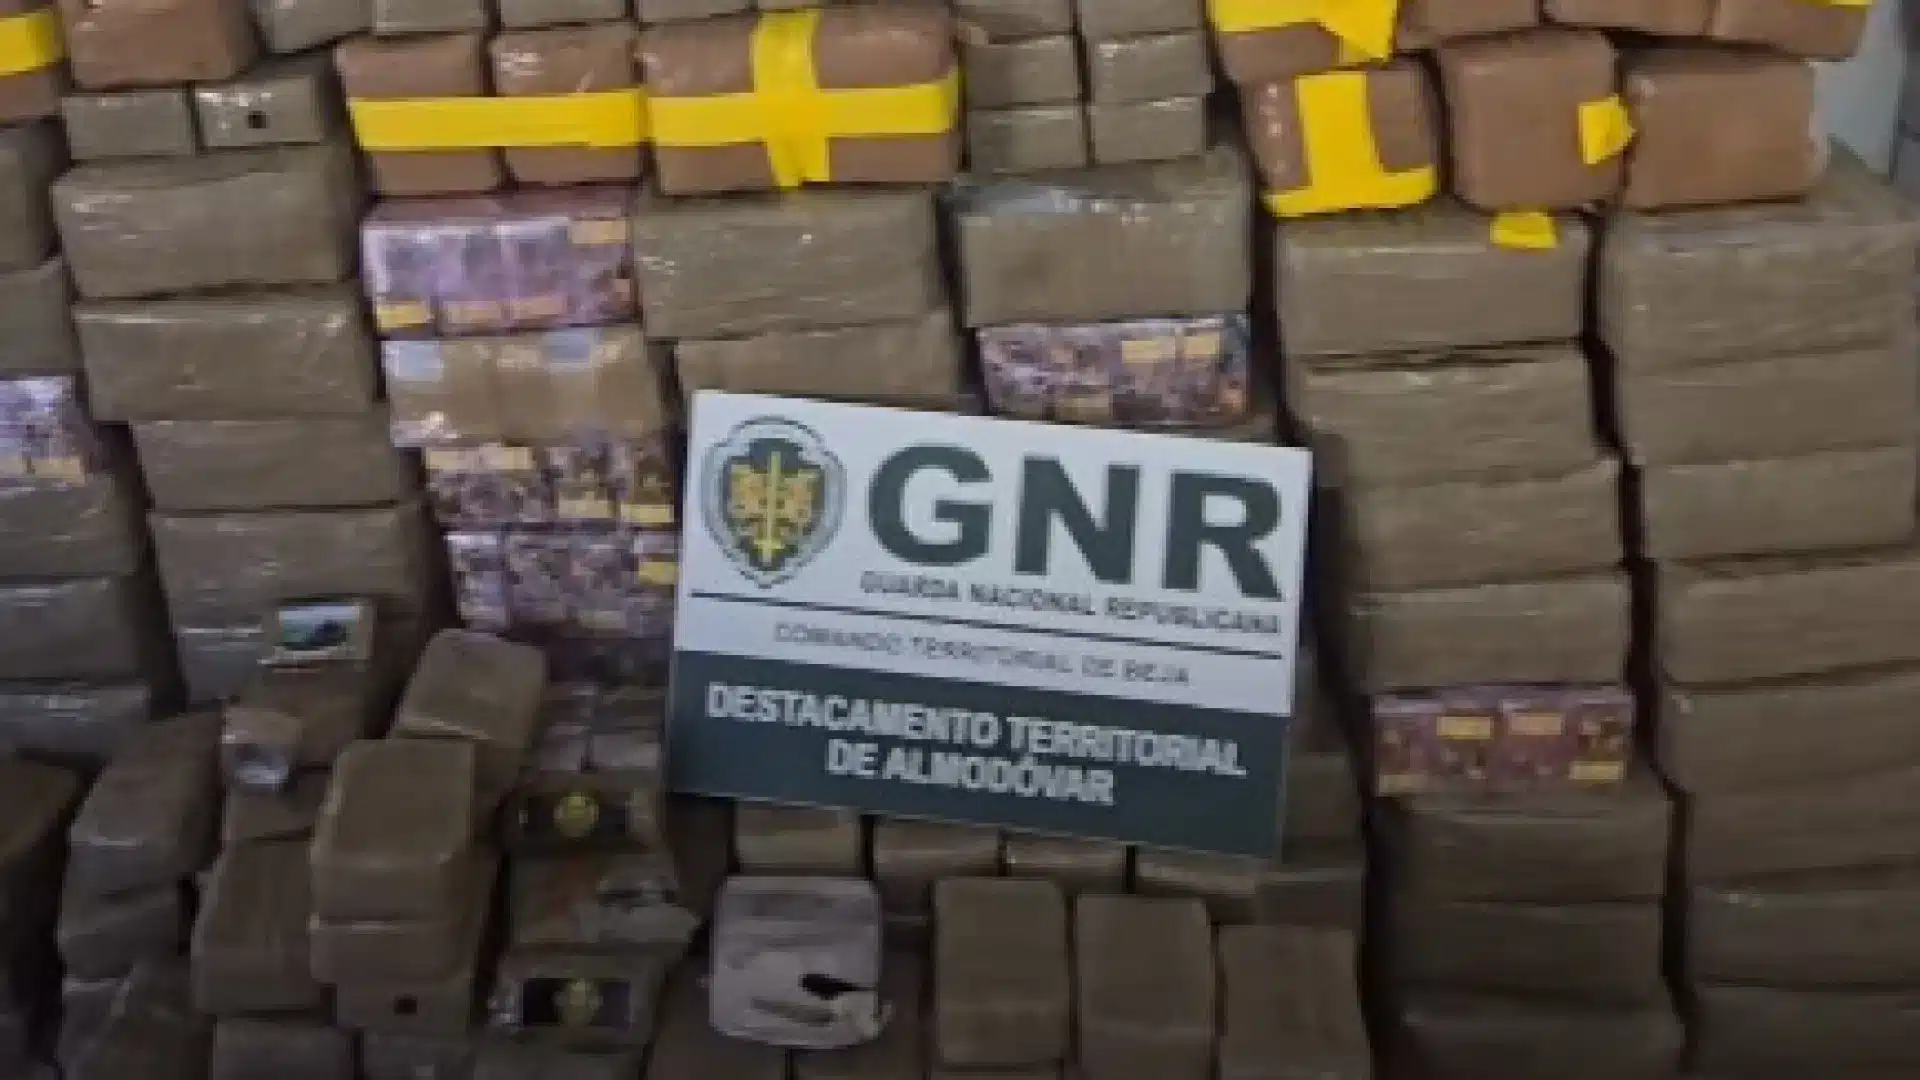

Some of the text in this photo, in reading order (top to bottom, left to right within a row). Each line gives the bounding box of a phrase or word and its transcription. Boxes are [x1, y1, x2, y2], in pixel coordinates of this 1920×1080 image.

[869, 444, 1283, 598] GNR
[859, 571, 959, 598] GUARDA
[969, 583, 1096, 616] NACIONAL
[775, 624, 902, 655] COMANDO
[1080, 658, 1115, 680] DE
[1122, 661, 1191, 686] BEJA
[707, 682, 1247, 776] DESTACAMENTO TERRITORIAL
[825, 740, 1116, 806] DE ALMODÓVAR
